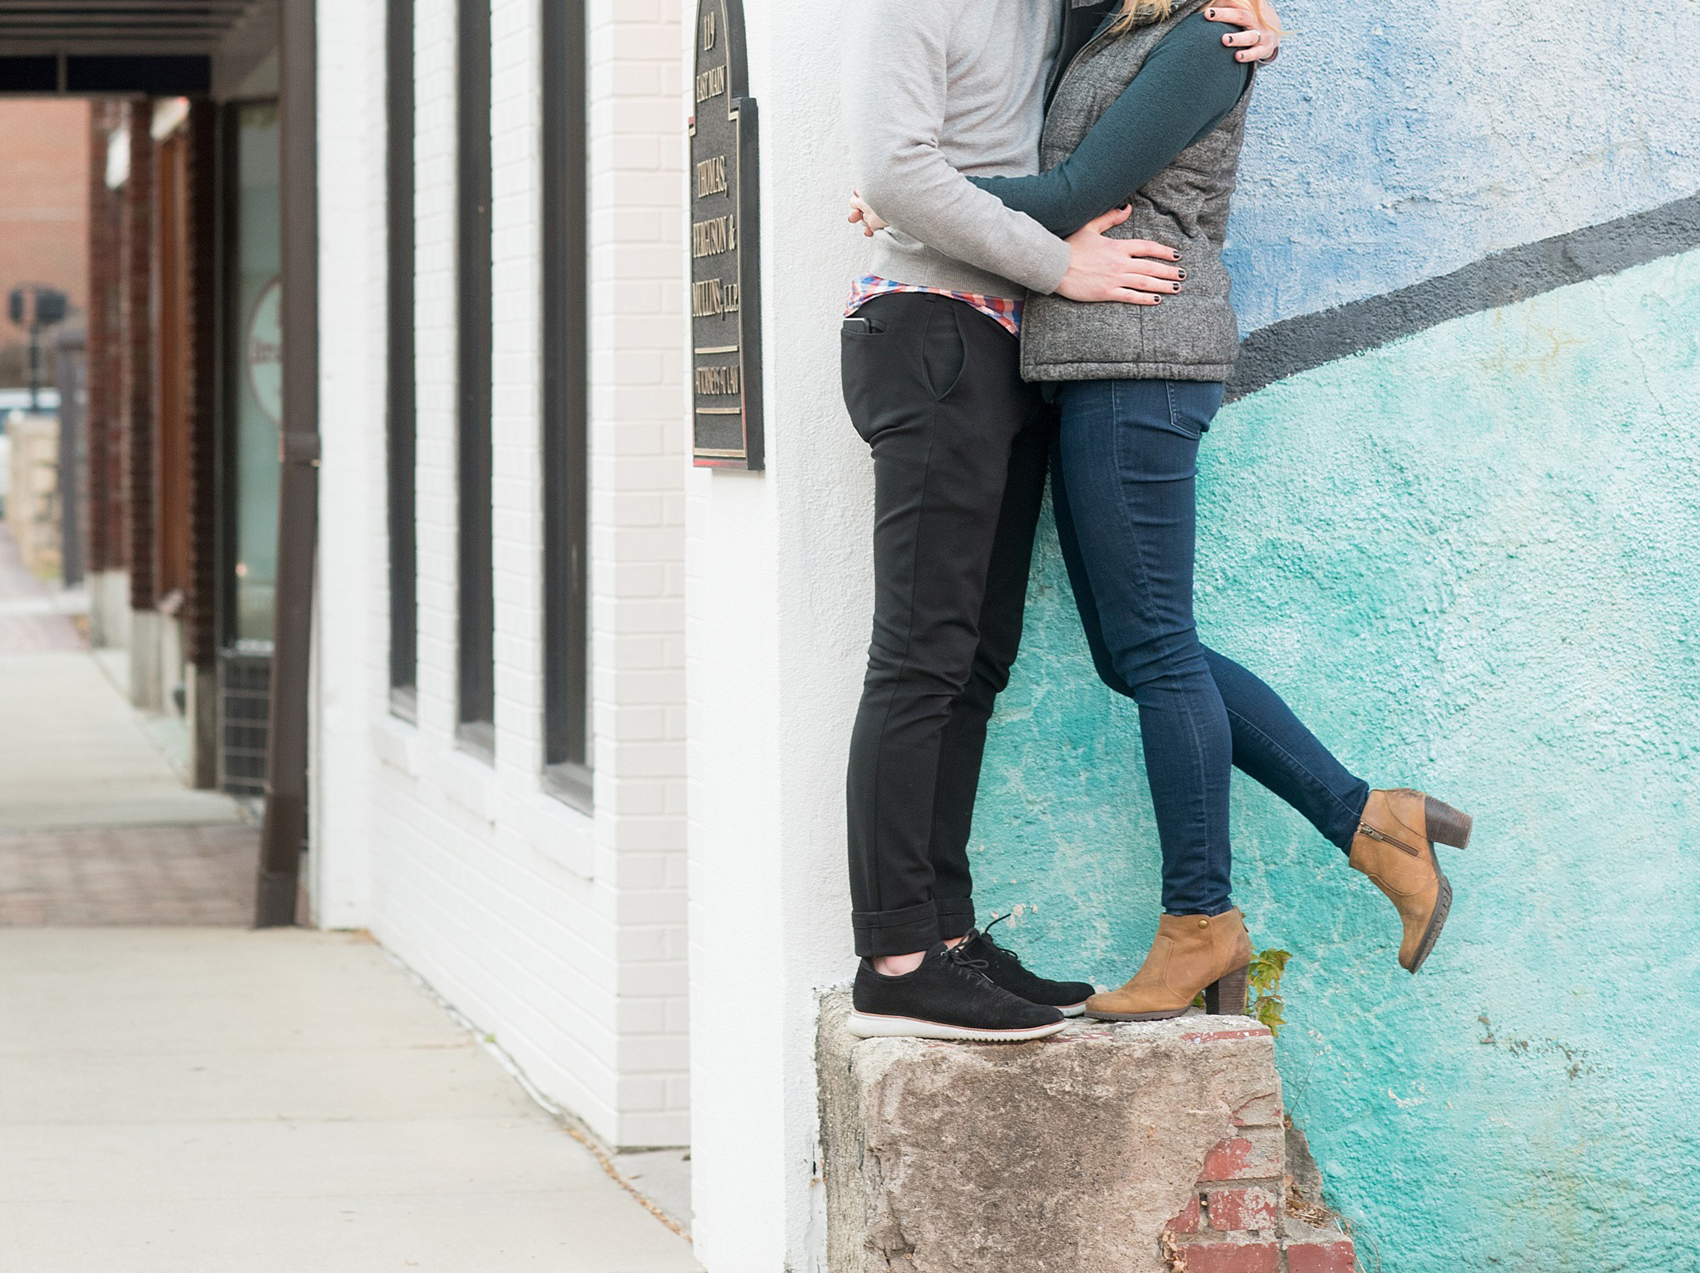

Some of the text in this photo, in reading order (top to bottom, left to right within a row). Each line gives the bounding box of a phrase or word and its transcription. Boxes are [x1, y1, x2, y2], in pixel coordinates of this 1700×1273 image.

[703, 11, 716, 52] 119
[709, 65, 725, 99] MAIN
[697, 156, 728, 198] THOMAS,
[729, 214, 736, 251] &
